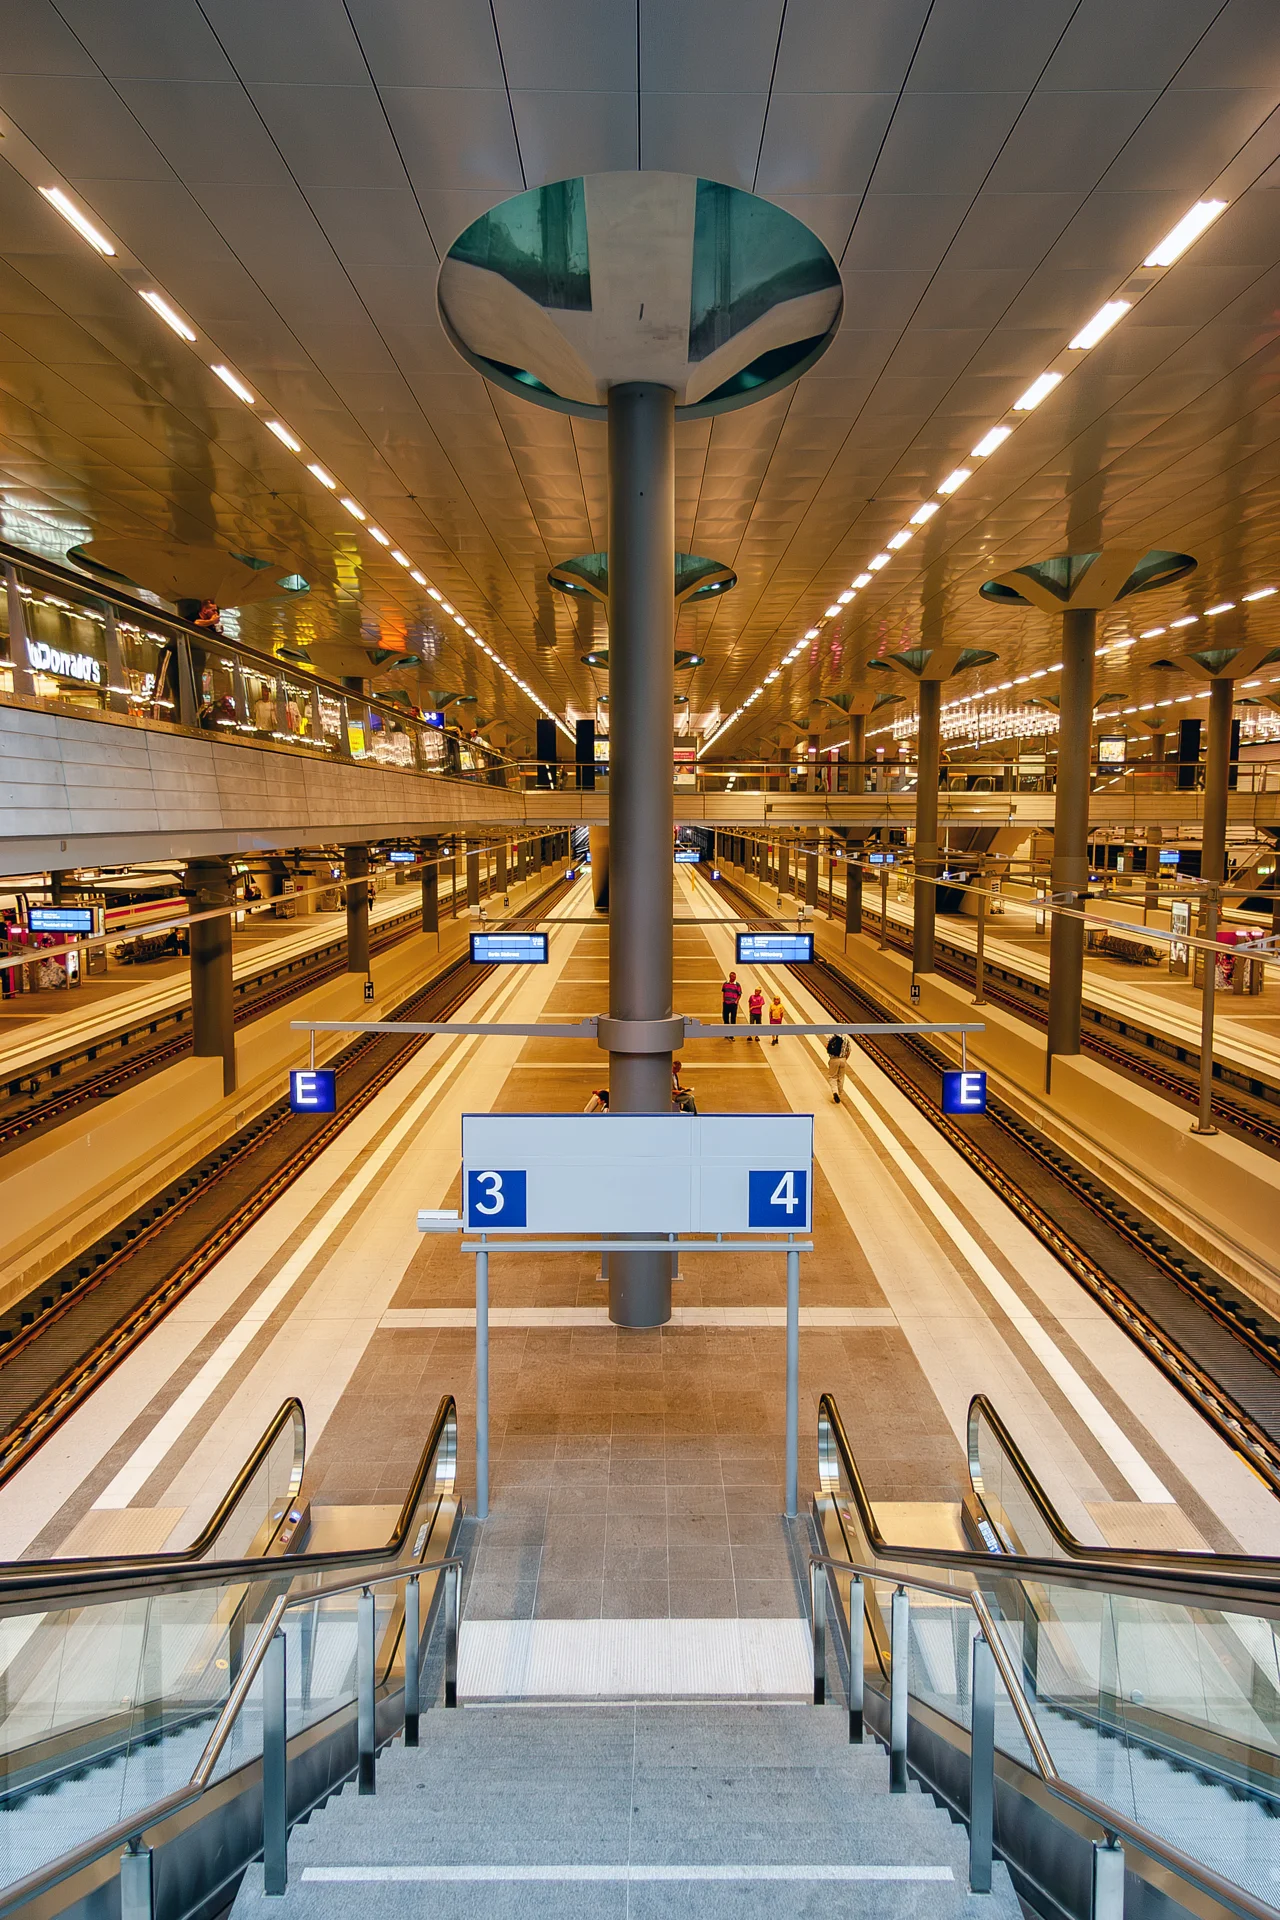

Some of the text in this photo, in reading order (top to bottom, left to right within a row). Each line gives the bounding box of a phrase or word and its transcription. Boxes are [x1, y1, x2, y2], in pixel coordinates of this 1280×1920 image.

[26, 637, 100, 683] cDonald's
[566, 870, 572, 879] F
[713, 870, 720, 879] F
[84, 911, 91, 919] 2
[474, 937, 480, 946] 3
[803, 936, 809, 946] 4
[366, 988, 373, 997] H
[911, 986, 919, 996] H
[296, 1072, 318, 1104] E
[961, 1073, 981, 1104] E
[475, 1171, 505, 1215] 3
[770, 1171, 799, 1214] 4
